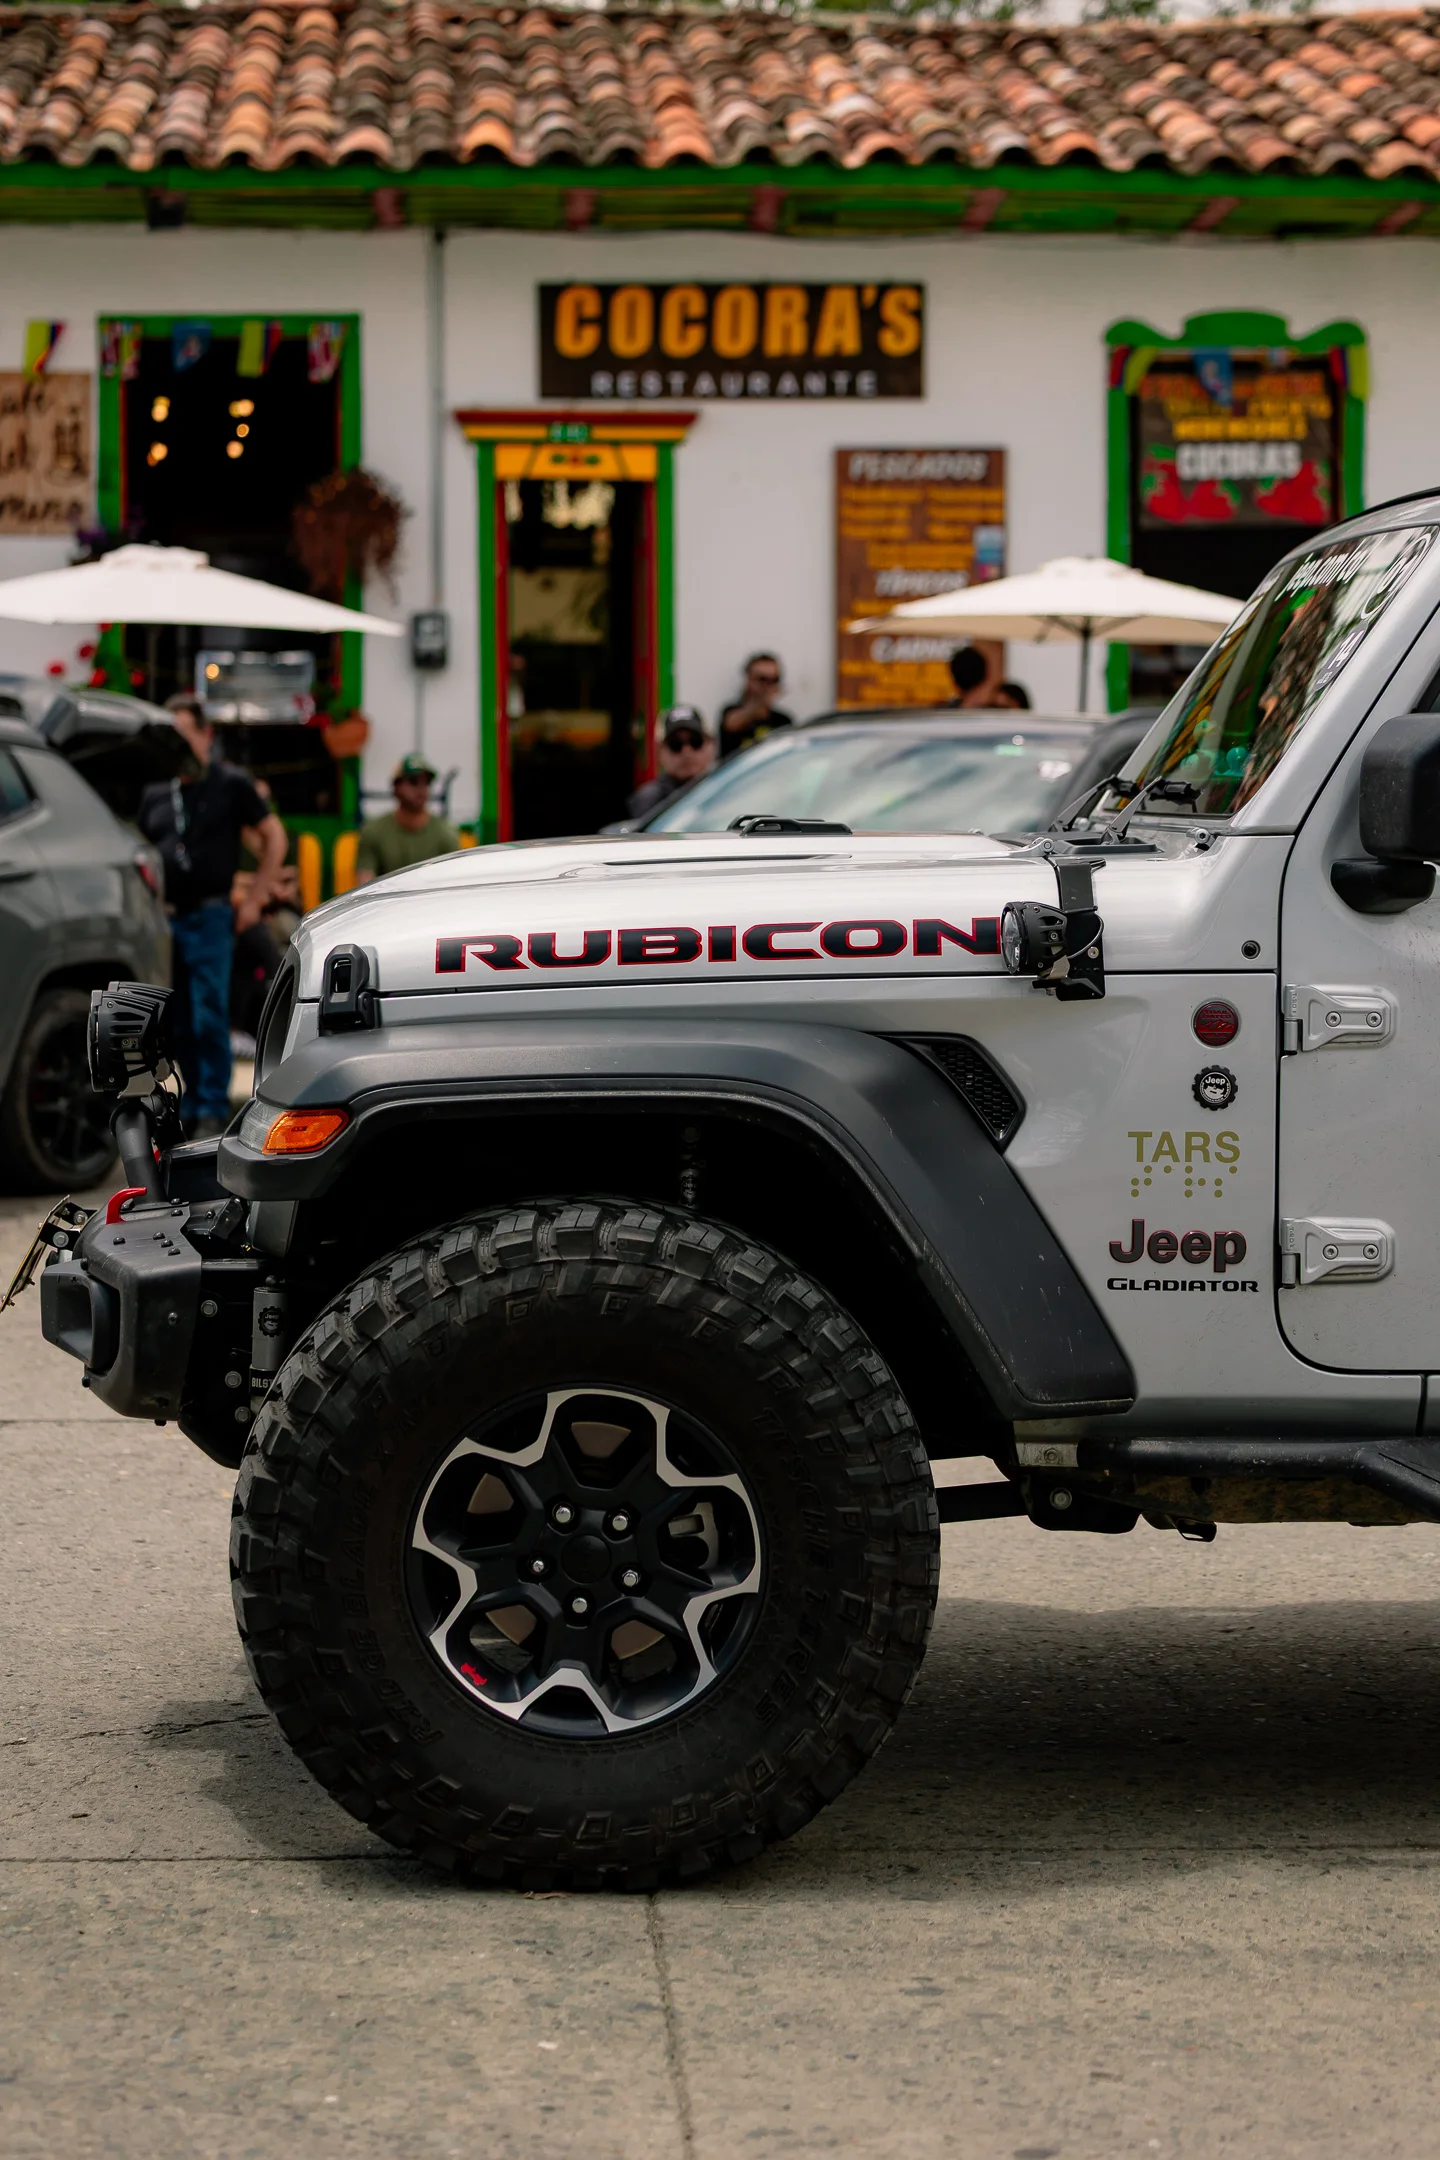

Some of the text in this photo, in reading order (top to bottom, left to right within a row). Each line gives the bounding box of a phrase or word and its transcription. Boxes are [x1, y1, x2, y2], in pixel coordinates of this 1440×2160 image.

[554, 284, 922, 359] COCORA'S
[591, 370, 878, 398] RESTAURANTE
[435, 917, 1000, 973] RUBICON
[1205, 1076, 1226, 1086] Jeep
[1128, 1131, 1240, 1163] TARS
[1109, 1219, 1247, 1273] Jeep
[1107, 1278, 1259, 1292] GLADIATOR
